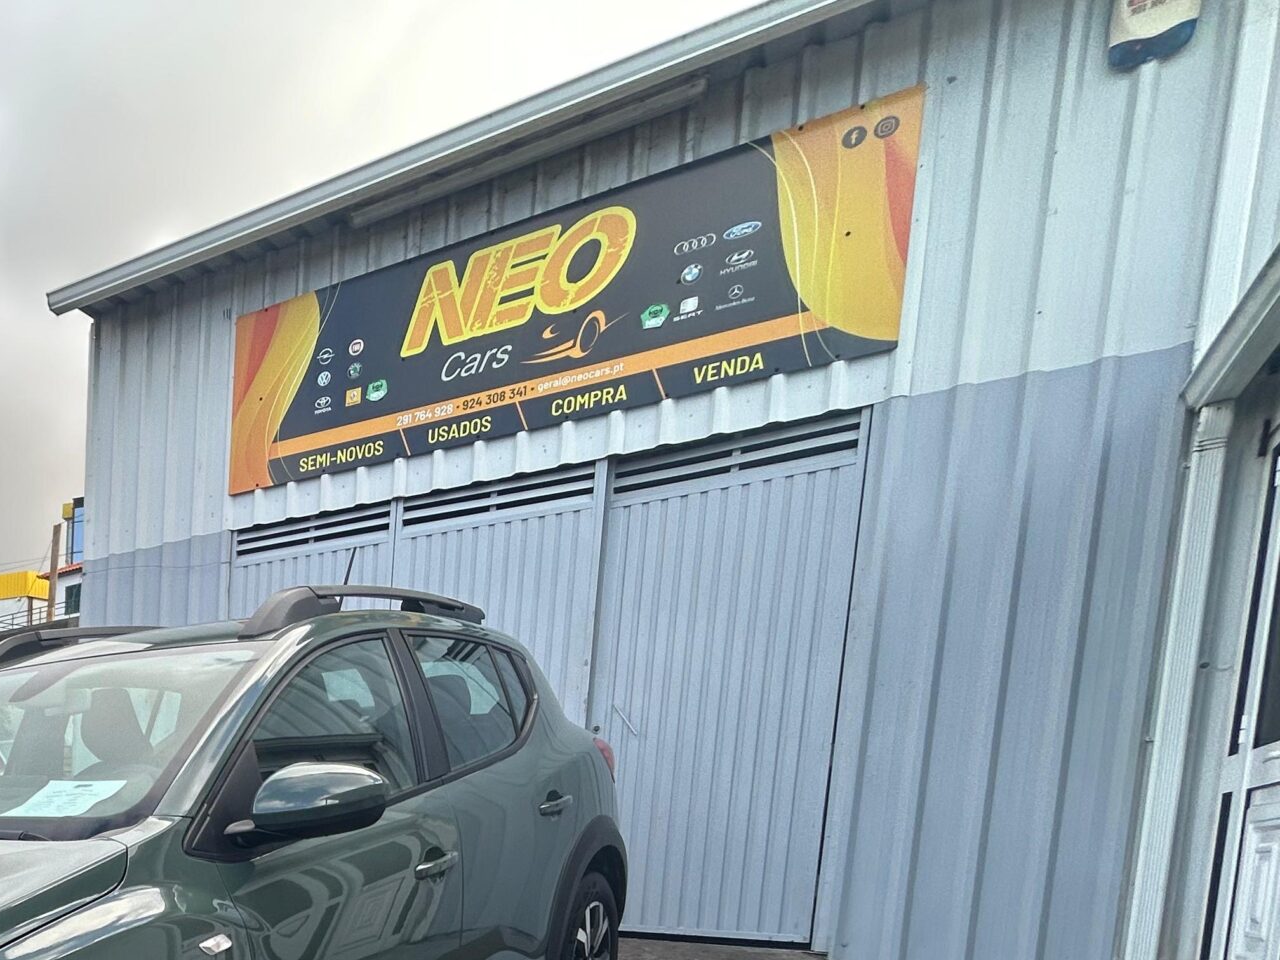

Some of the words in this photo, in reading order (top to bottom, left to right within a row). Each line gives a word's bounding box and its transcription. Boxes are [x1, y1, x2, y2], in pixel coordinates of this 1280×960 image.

[399, 206, 637, 358] NEO
[441, 345, 513, 382] Cars
[693, 352, 764, 384] VENDA
[396, 411, 413, 426] 291
[414, 407, 433, 422] 764
[434, 403, 454, 418] 928
[462, 395, 482, 411] 924
[485, 391, 506, 405] 308
[508, 385, 527, 401] 341
[537, 363, 625, 392] geral@neocars.pt
[551, 384, 627, 416] COMPRA
[427, 415, 492, 444] USADOS
[299, 440, 384, 472] SEMI-NOVOS
